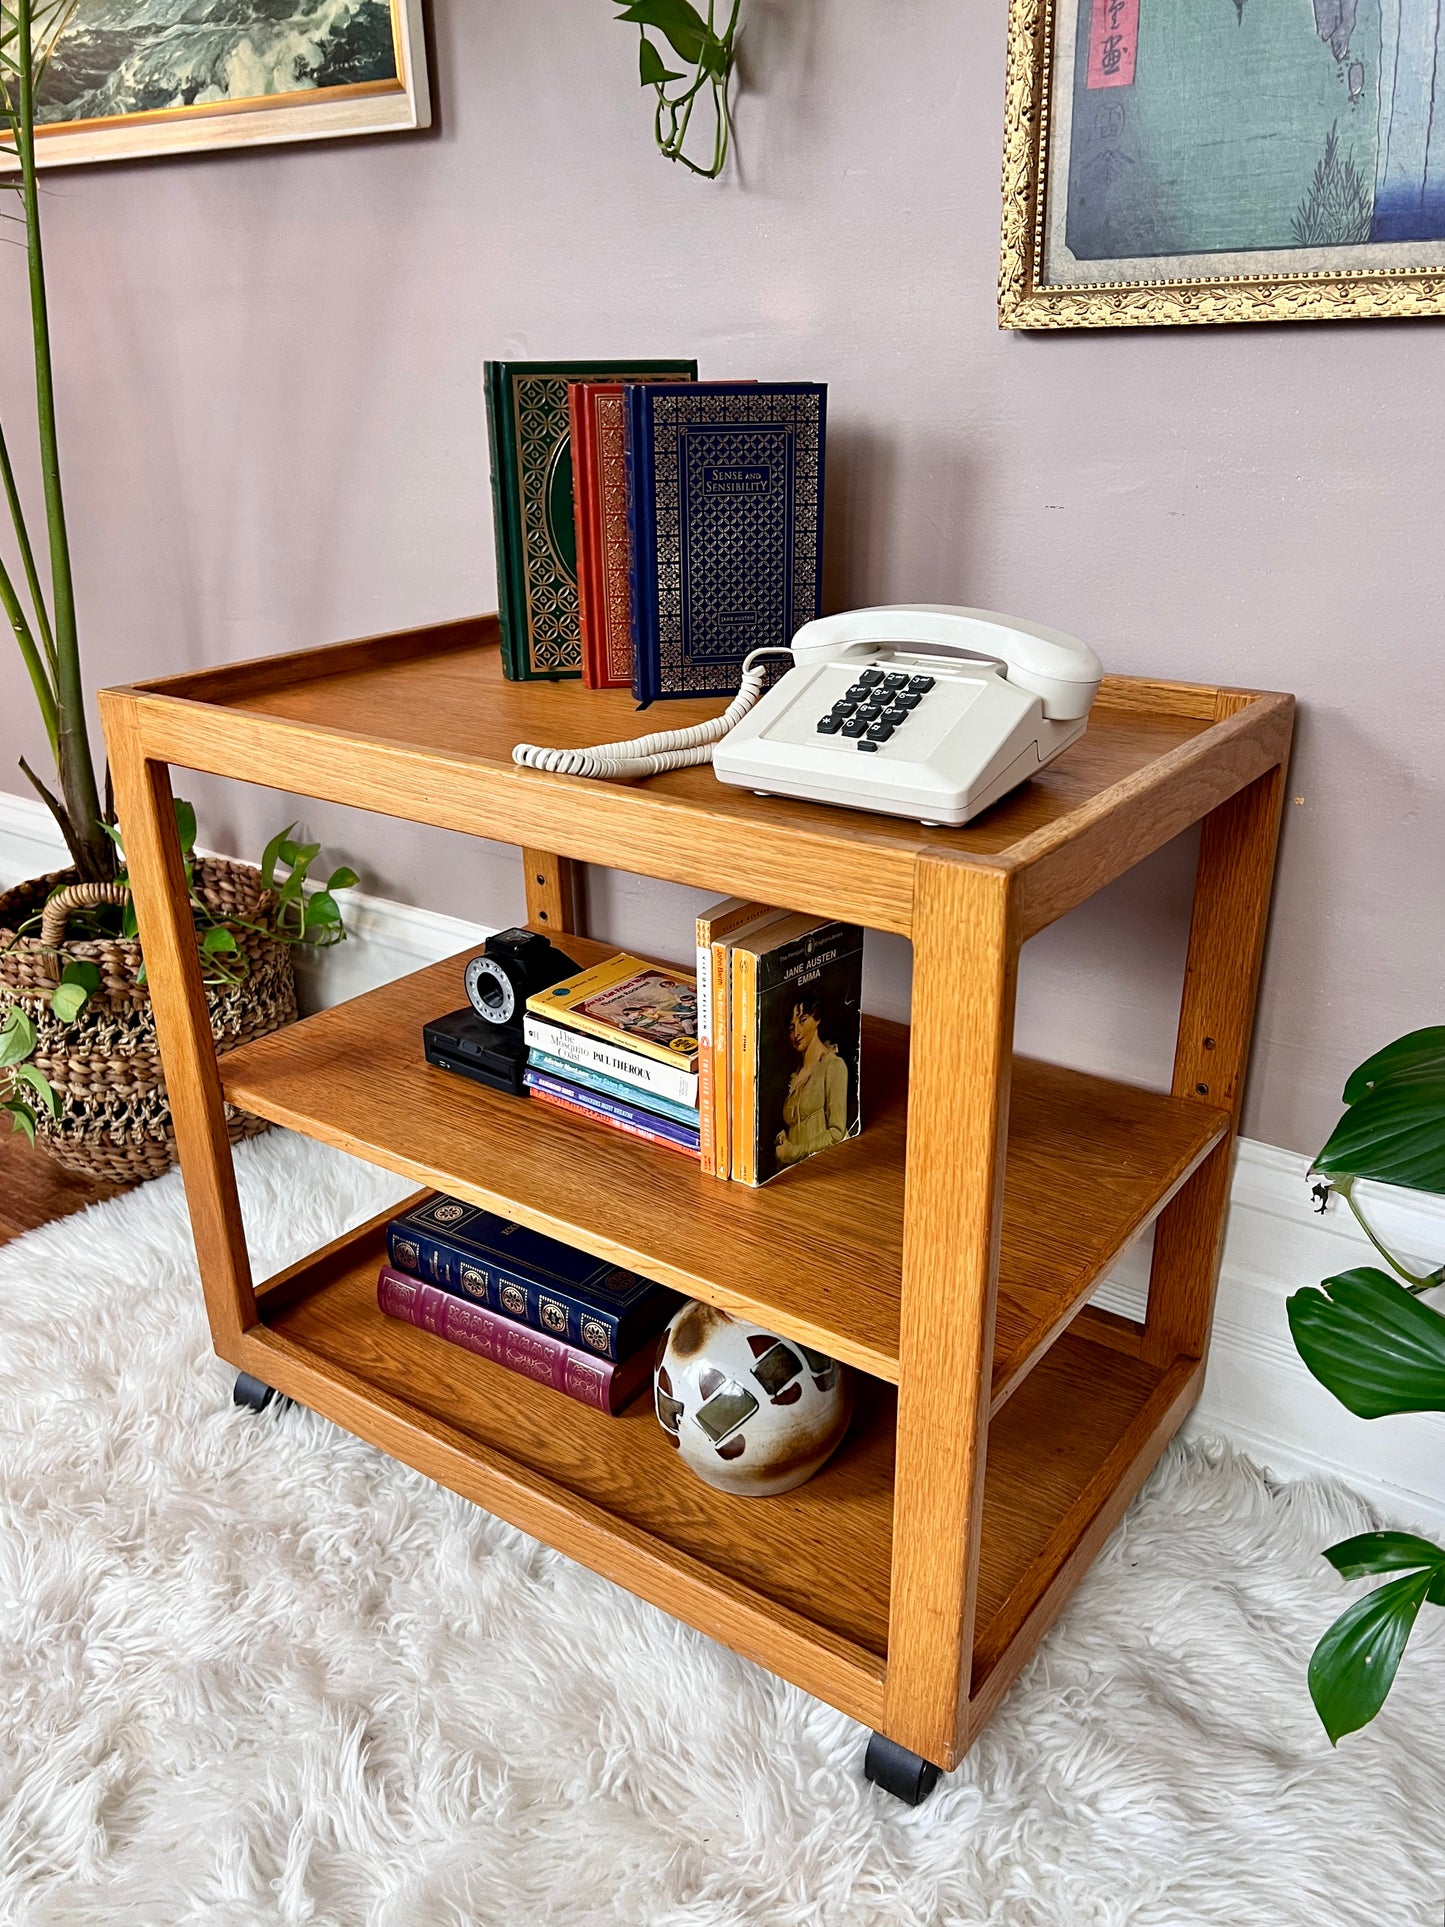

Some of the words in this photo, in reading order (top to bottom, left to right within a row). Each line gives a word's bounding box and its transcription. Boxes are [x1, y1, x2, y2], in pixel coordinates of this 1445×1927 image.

[712, 469, 743, 481] SENSE
[706, 480, 768, 493] SENSIBILITY
[783, 964, 804, 980] JANE
[805, 948, 837, 970] AUSTEN
[797, 969, 821, 986] EMMA
[559, 1030, 575, 1044] The
[551, 1034, 590, 1057] Mosquito
[557, 1047, 581, 1062] Coast
[593, 1051, 612, 1066] PAUL
[612, 1058, 651, 1081] THEROUX
